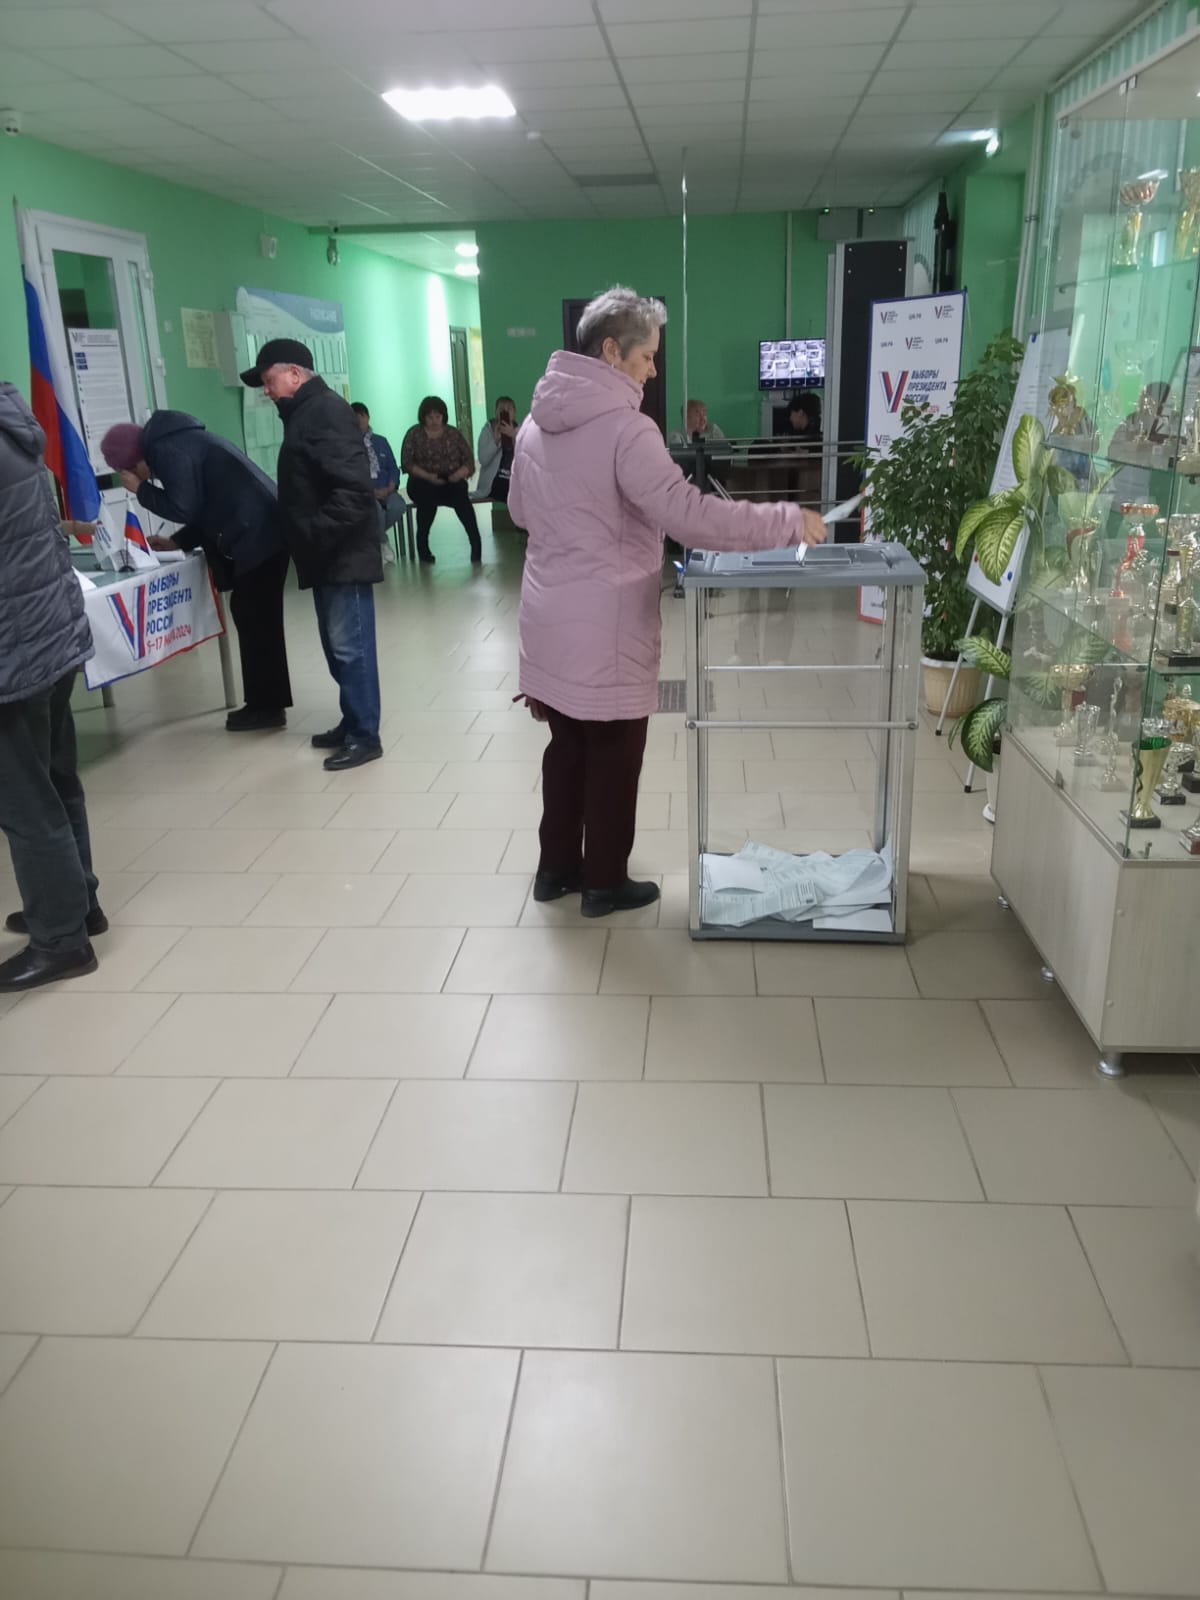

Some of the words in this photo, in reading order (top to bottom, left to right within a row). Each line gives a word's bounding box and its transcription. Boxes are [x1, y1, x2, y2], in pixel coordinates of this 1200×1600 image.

[911, 369, 940, 380] ВЫБОРЫ
[907, 381, 947, 392] ПРЕЗИДЕНТА
[146, 612, 174, 637] РОССИ
